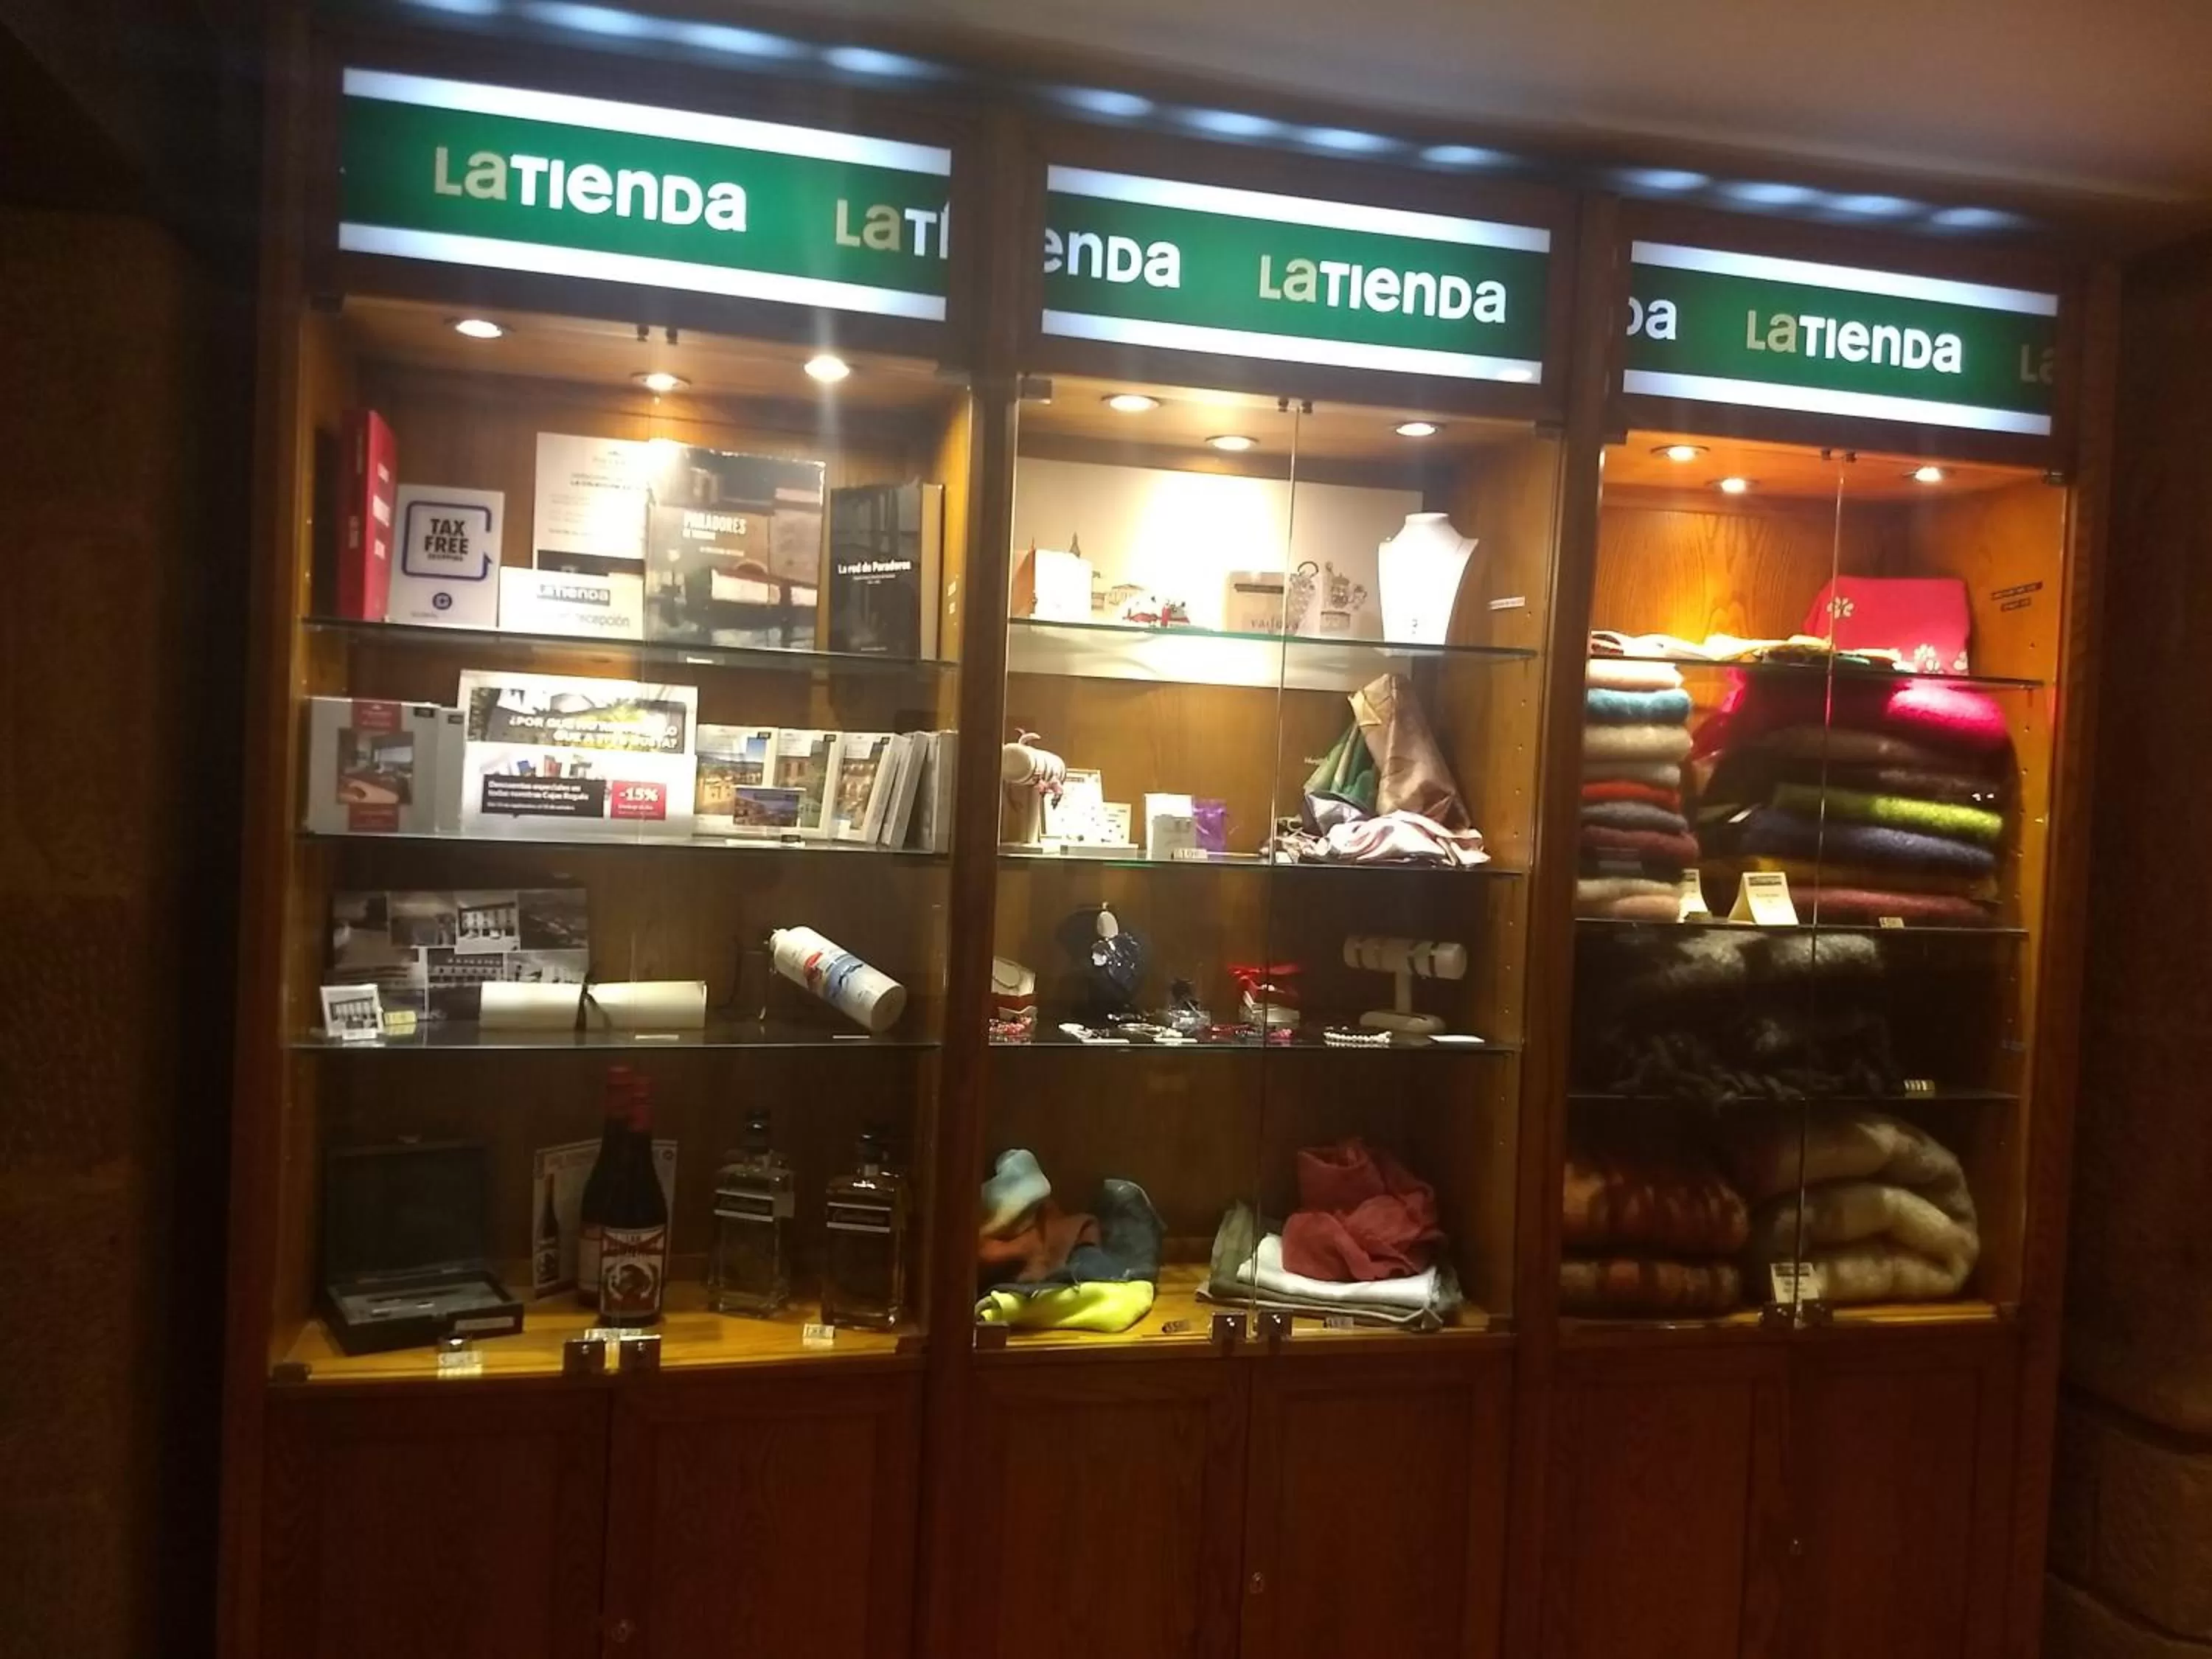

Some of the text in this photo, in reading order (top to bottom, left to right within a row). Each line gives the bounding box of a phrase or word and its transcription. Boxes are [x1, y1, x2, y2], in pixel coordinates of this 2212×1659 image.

[430, 518, 465, 537] TAX
[424, 535, 470, 554] FREE
[618, 787, 659, 803] -15%
